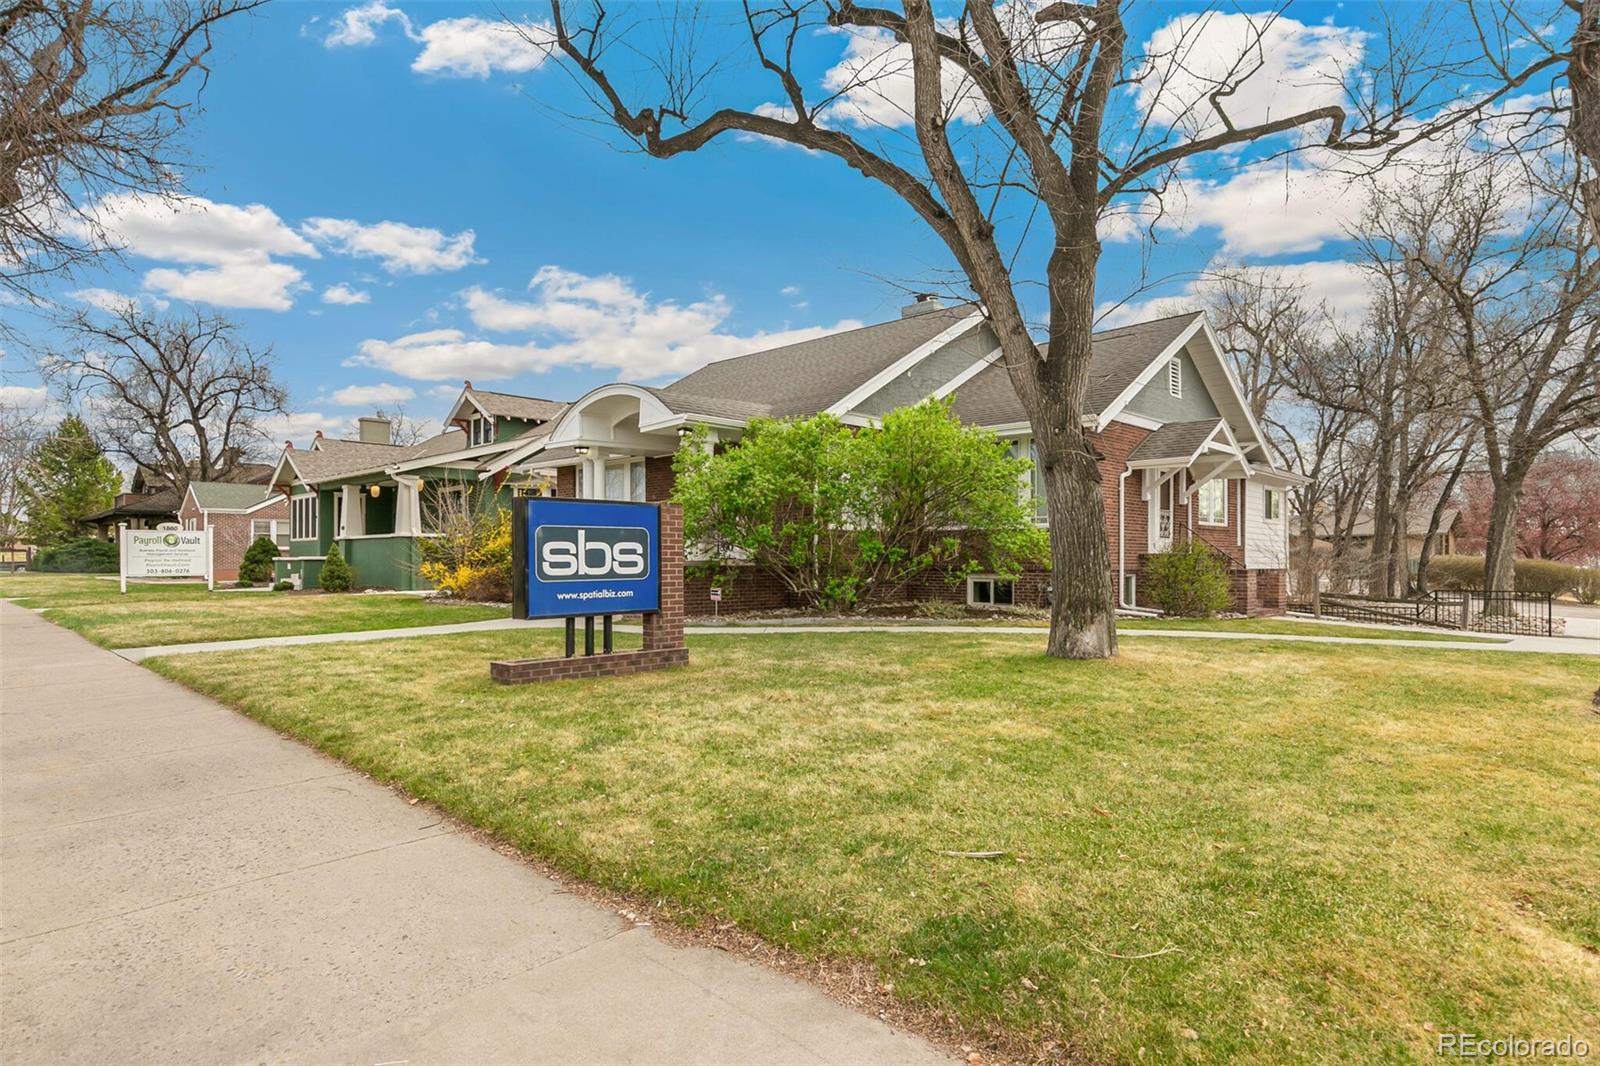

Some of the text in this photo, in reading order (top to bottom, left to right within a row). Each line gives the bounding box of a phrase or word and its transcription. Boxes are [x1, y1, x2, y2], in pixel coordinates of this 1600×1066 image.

[133, 535, 201, 546] Payroll Vault
[542, 529, 644, 576] sbs
[556, 589, 634, 601] www.spatialbiz.com
